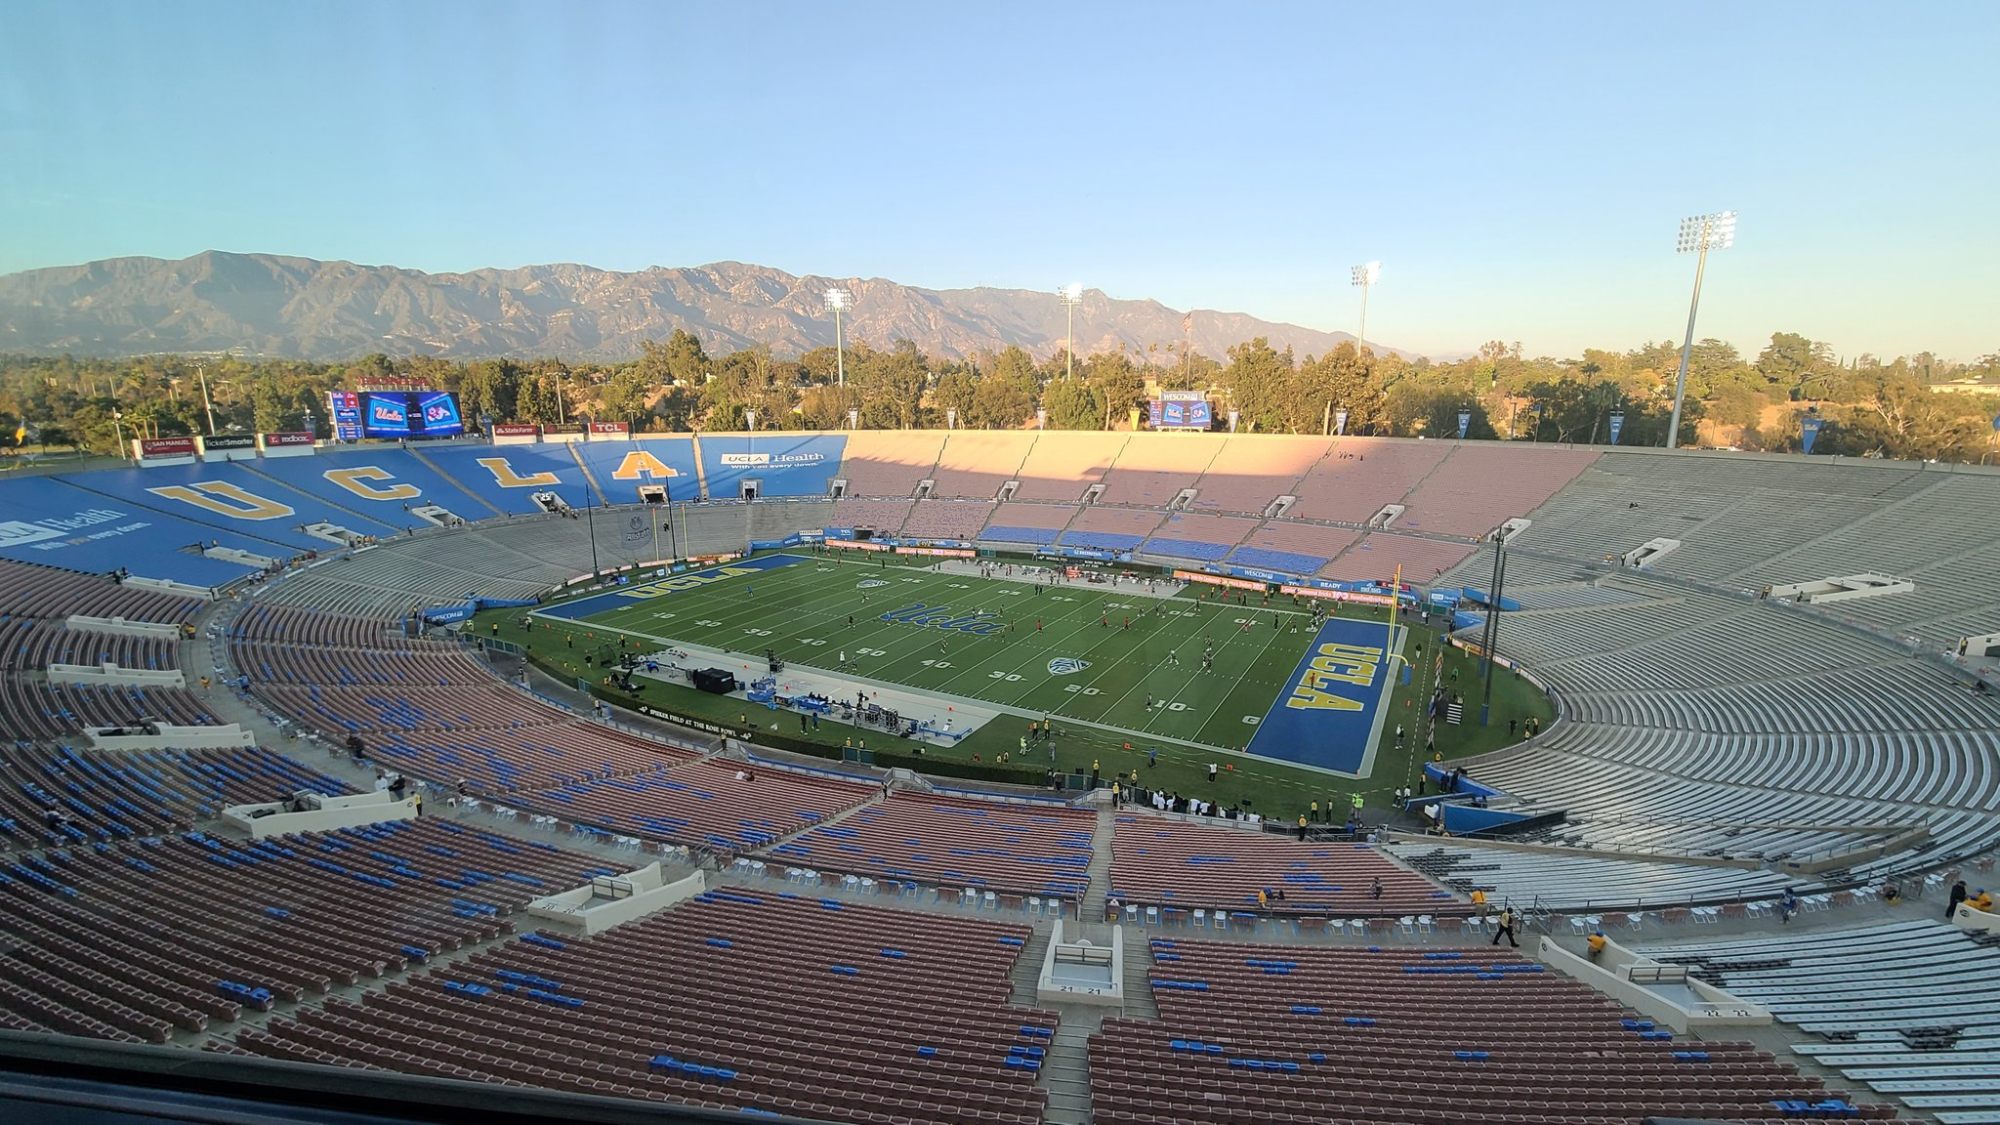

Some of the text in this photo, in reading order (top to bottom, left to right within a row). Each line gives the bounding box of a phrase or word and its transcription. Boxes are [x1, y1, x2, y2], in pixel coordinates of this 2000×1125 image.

[375, 407, 403, 421] Ucla
[774, 452, 824, 462] Health
[33, 509, 128, 531] Health
[616, 567, 764, 599] UCLA
[1245, 570, 1268, 579] WESCOM
[878, 603, 1008, 635] Ucla
[856, 648, 886, 656] 50
[921, 659, 950, 669] 40
[988, 670, 1022, 682] 30
[1064, 684, 1100, 696] 20
[1154, 700, 1188, 712] 10
[1286, 642, 1383, 712] UCLA
[669, 714, 684, 724] FIELD
[694, 722, 704, 730] THE
[706, 724, 719, 733] ROSE
